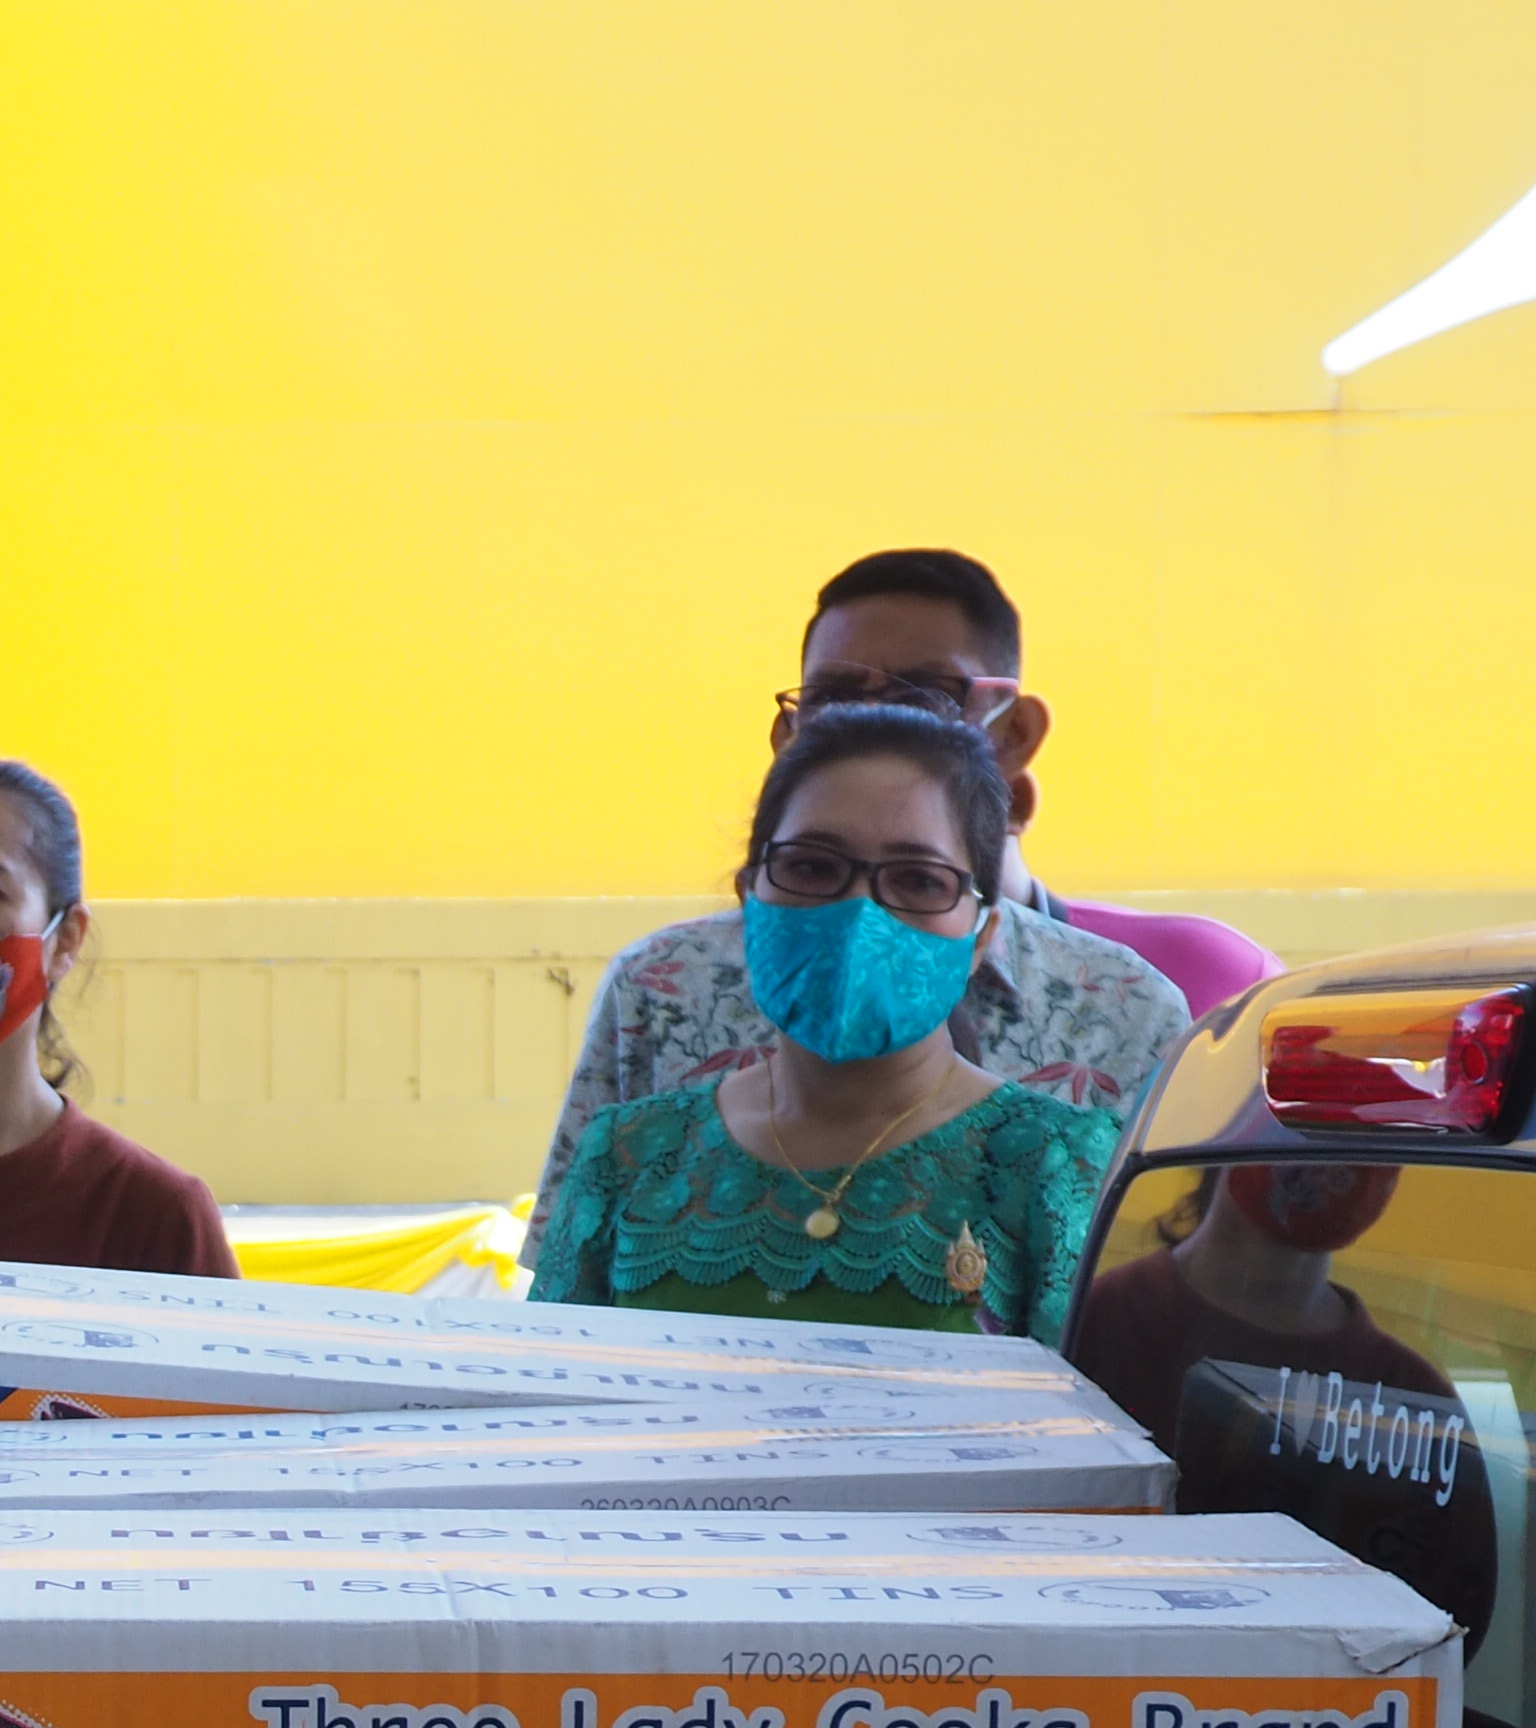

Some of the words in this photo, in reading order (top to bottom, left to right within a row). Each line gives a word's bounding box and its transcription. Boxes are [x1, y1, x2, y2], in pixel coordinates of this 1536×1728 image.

[1318, 1371, 1464, 1507] Betong
[68, 1467, 208, 1478] NET
[635, 1450, 829, 1464] TINS
[34, 1578, 213, 1592] NET
[285, 1579, 689, 1600] 155X100
[752, 1586, 1004, 1601] TINS
[722, 1651, 995, 1684] 170320A0502C
